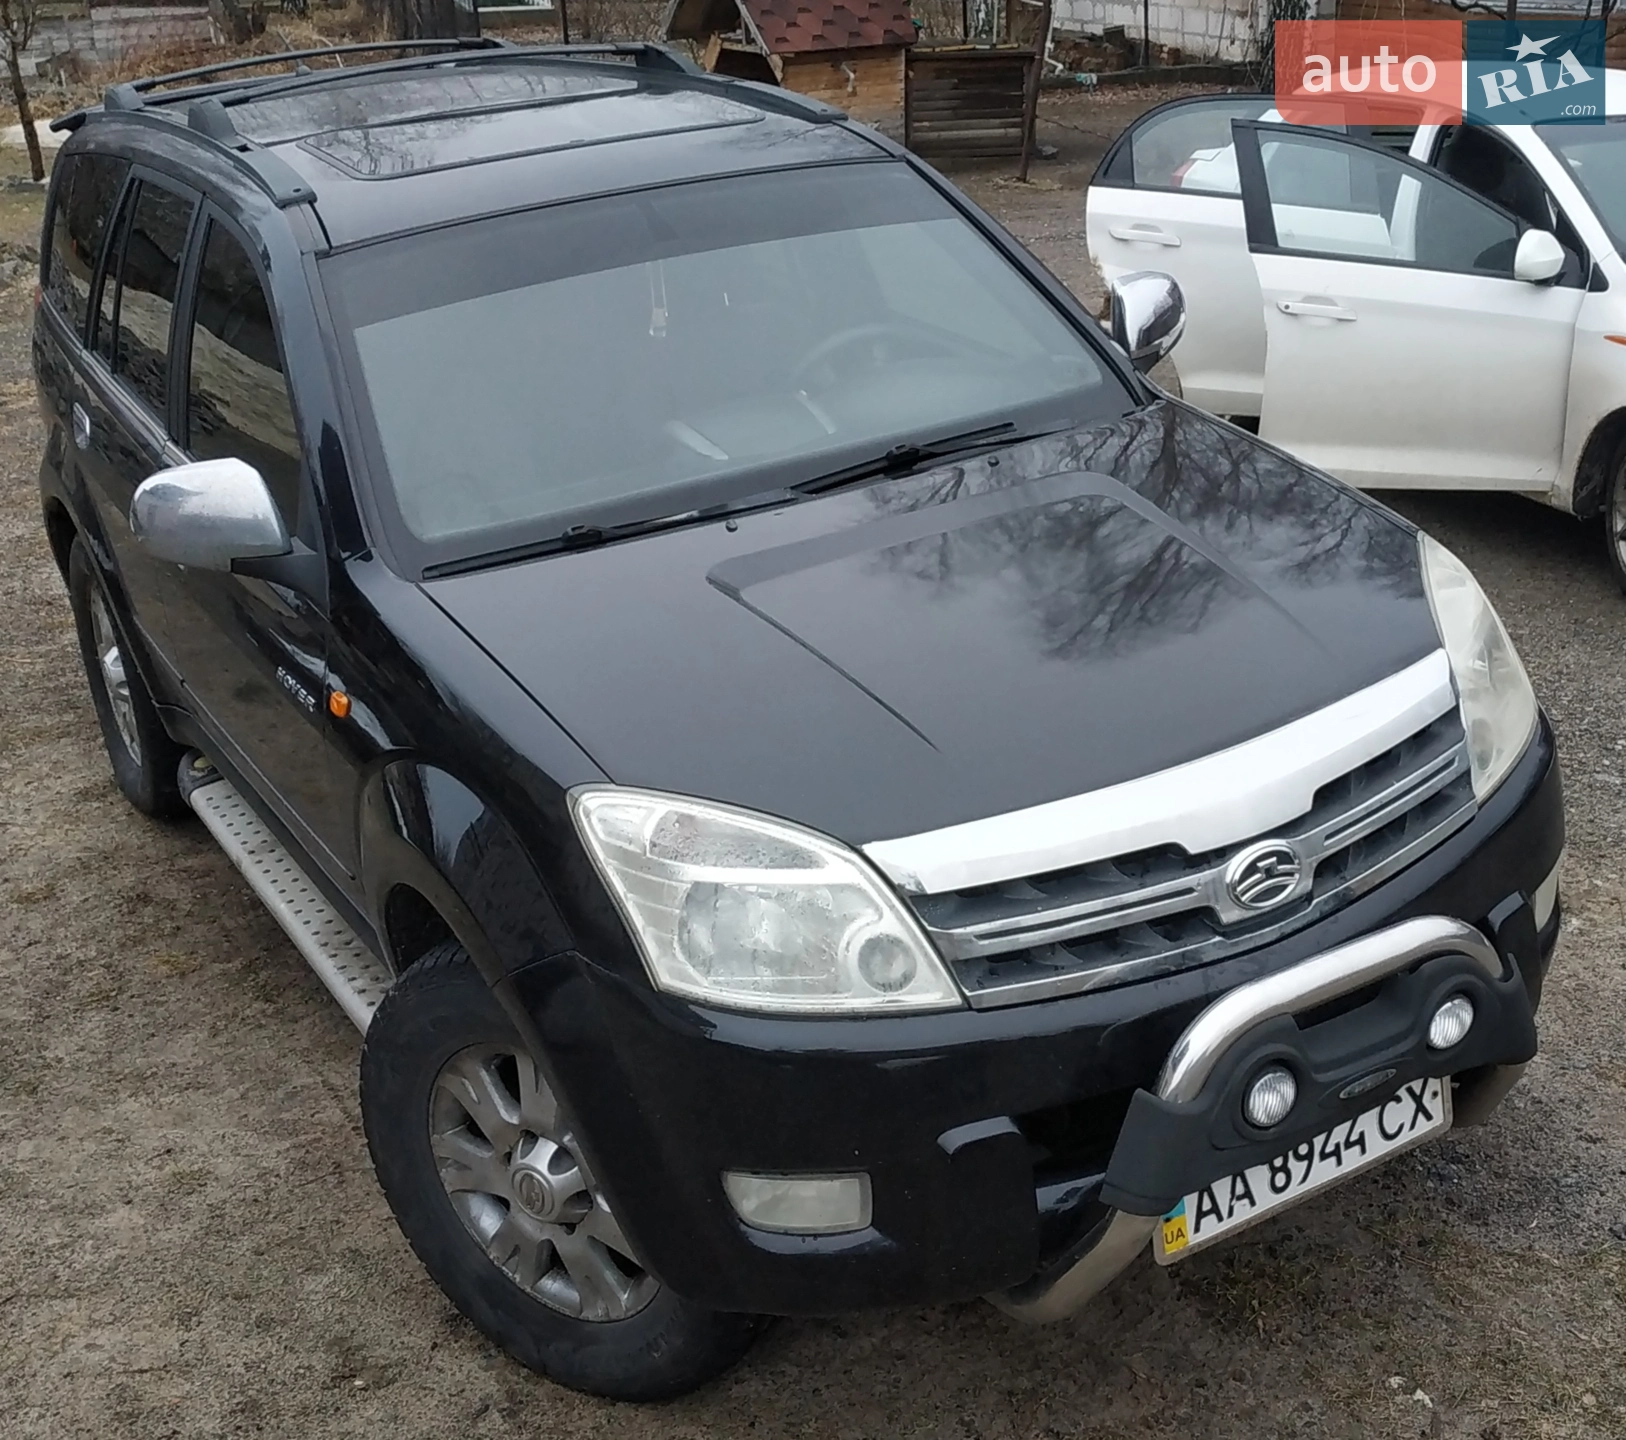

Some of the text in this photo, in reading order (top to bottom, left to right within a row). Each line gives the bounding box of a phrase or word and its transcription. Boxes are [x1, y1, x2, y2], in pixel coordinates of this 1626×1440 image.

[1193, 1173, 1257, 1235] AA
[1268, 1121, 1367, 1195] 8944
[1377, 1078, 1434, 1141] CX
[1164, 1227, 1186, 1245] UA
